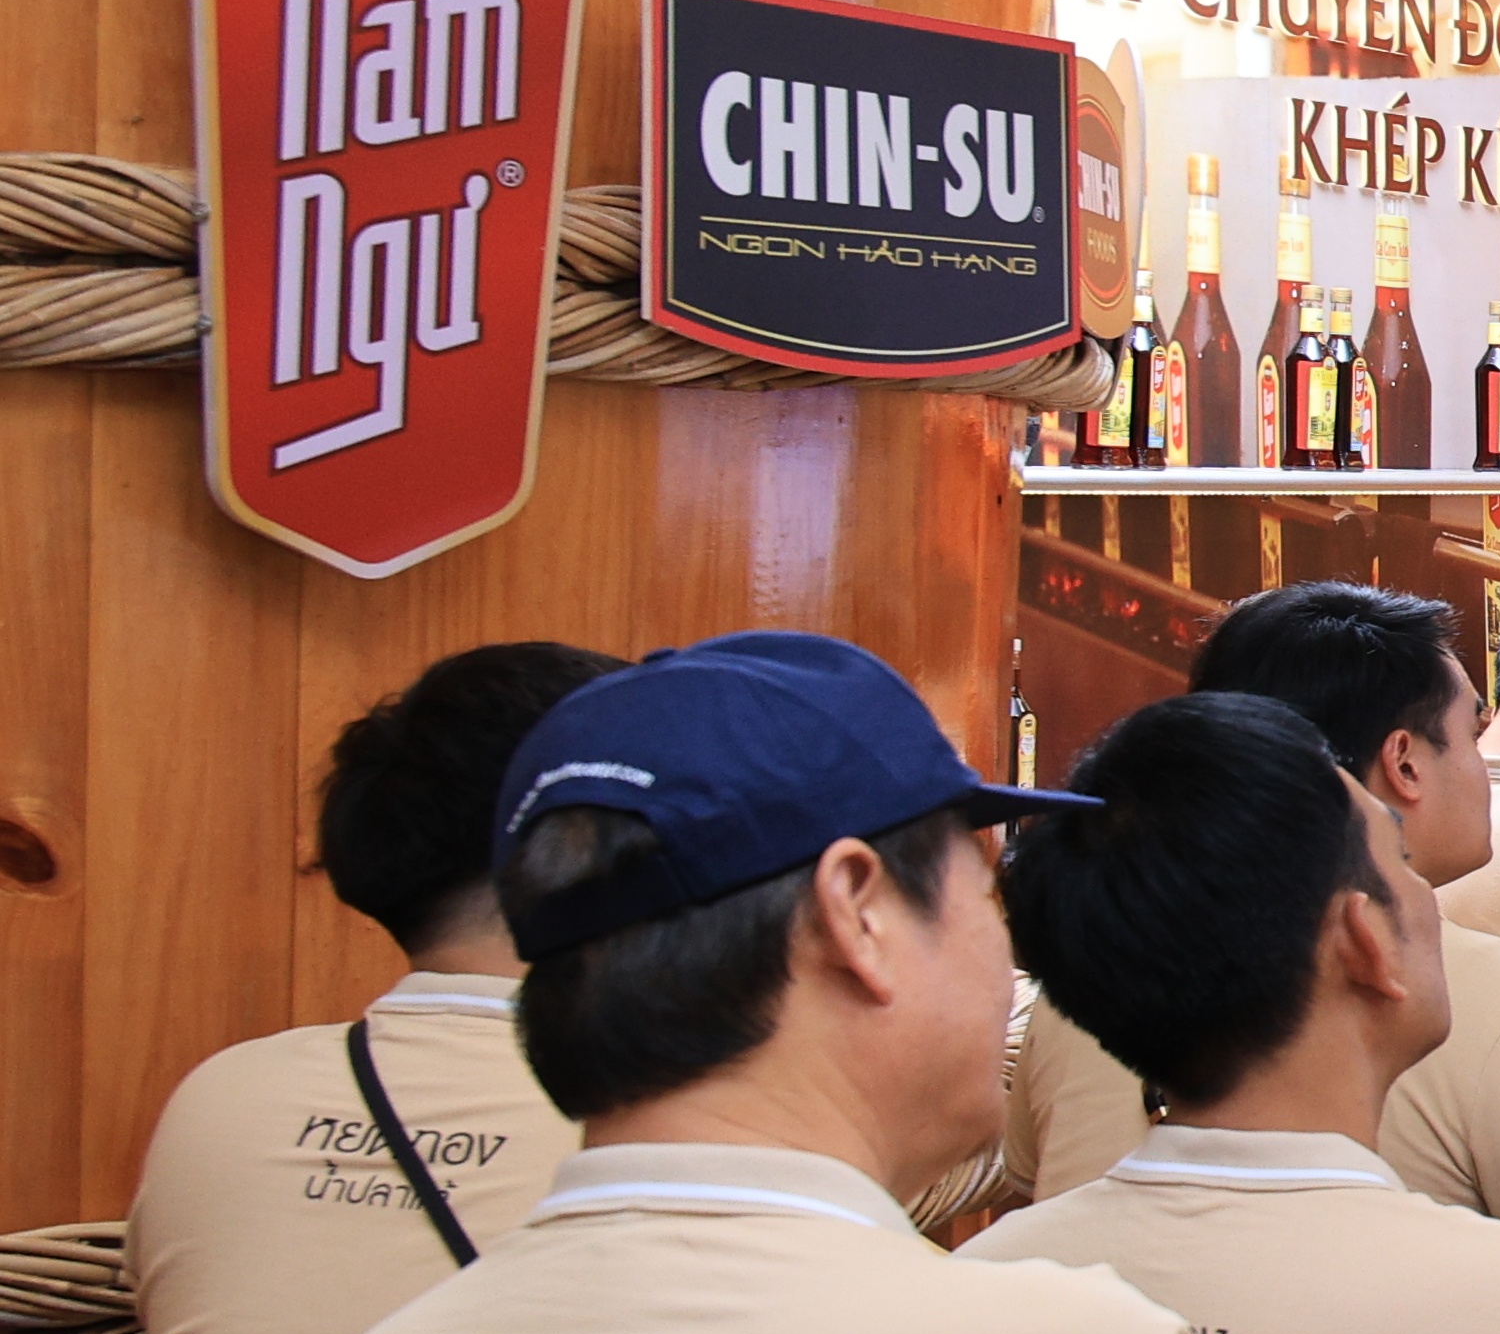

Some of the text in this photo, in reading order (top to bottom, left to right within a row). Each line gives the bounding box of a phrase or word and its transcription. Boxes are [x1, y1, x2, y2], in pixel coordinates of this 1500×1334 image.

[699, 70, 1035, 223] CHIN-SU
[1287, 90, 1447, 199] KHÉP
[699, 230, 1038, 279] NGON HẢO HẠNG
[269, 171, 490, 473] Ngư
